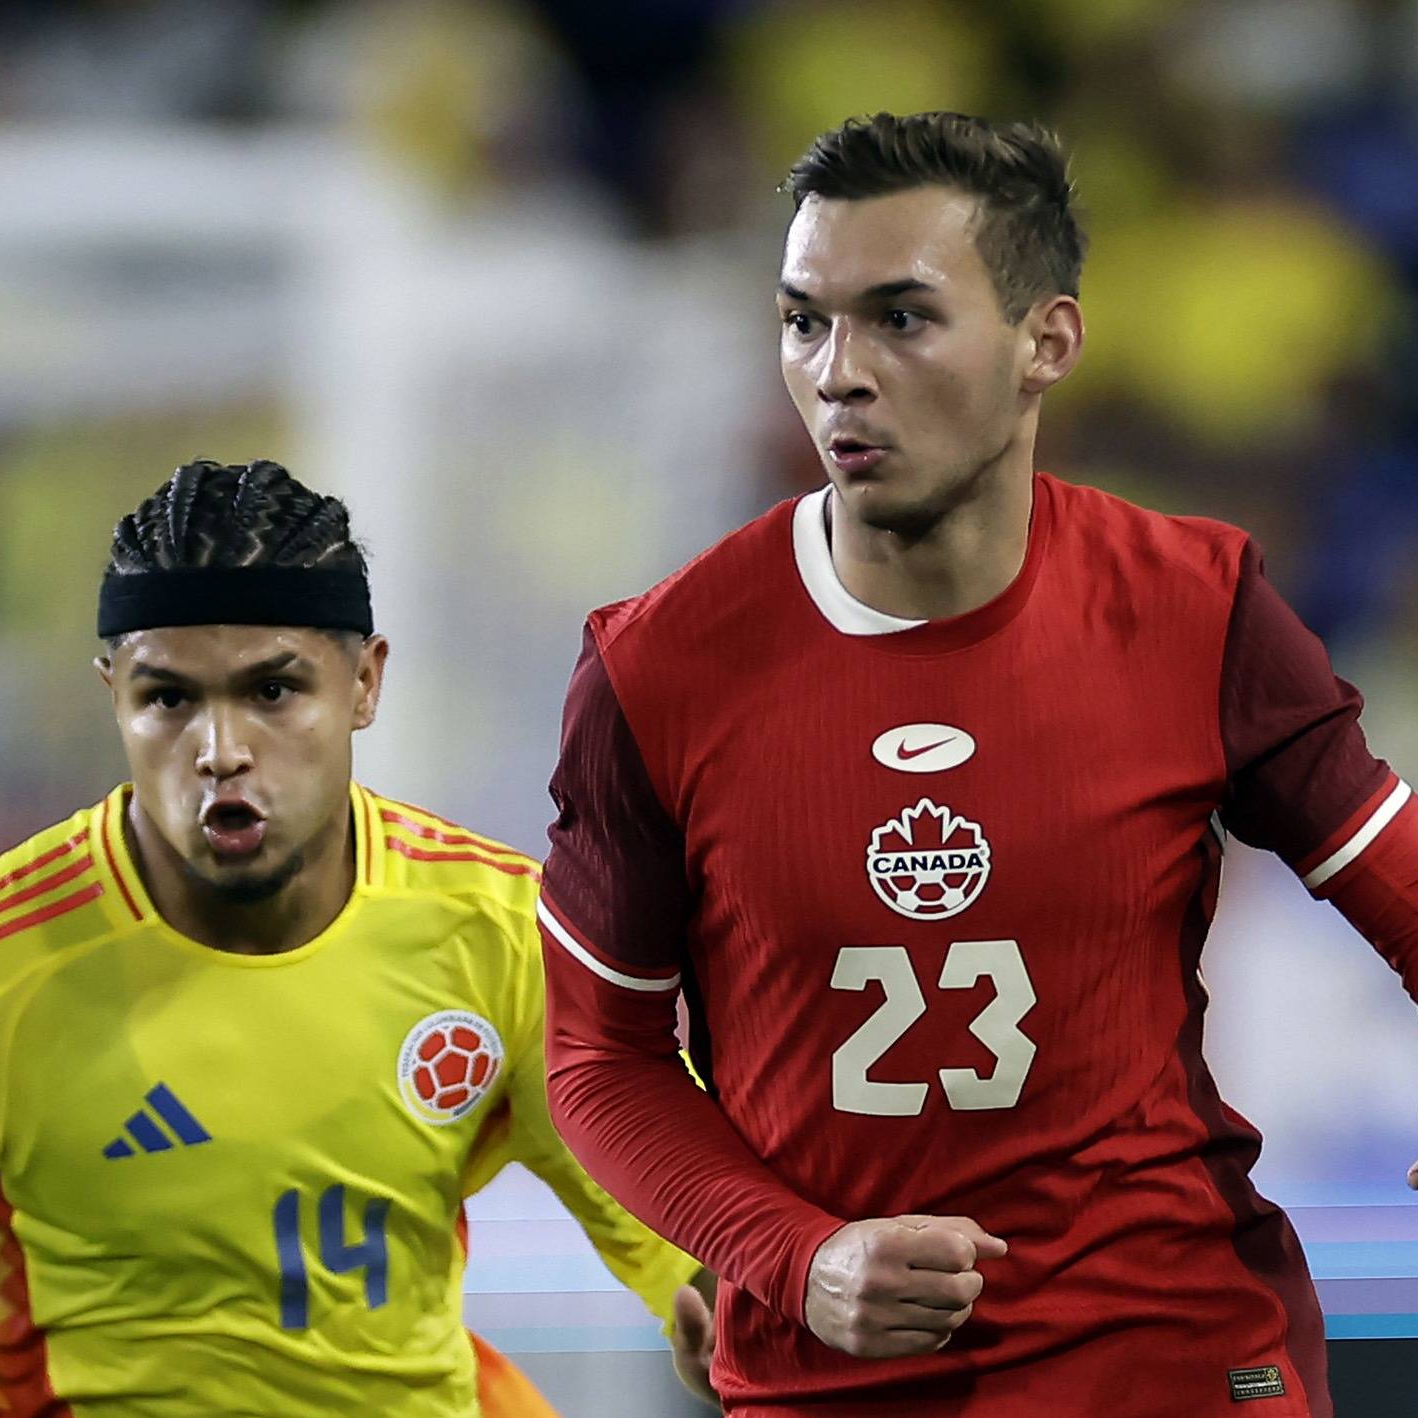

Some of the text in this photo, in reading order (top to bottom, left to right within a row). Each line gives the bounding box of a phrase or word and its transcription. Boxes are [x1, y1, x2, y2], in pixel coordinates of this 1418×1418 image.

[873, 853, 984, 873] CANADA
[830, 939, 1038, 1117] 23
[273, 1184, 390, 1329] 14
